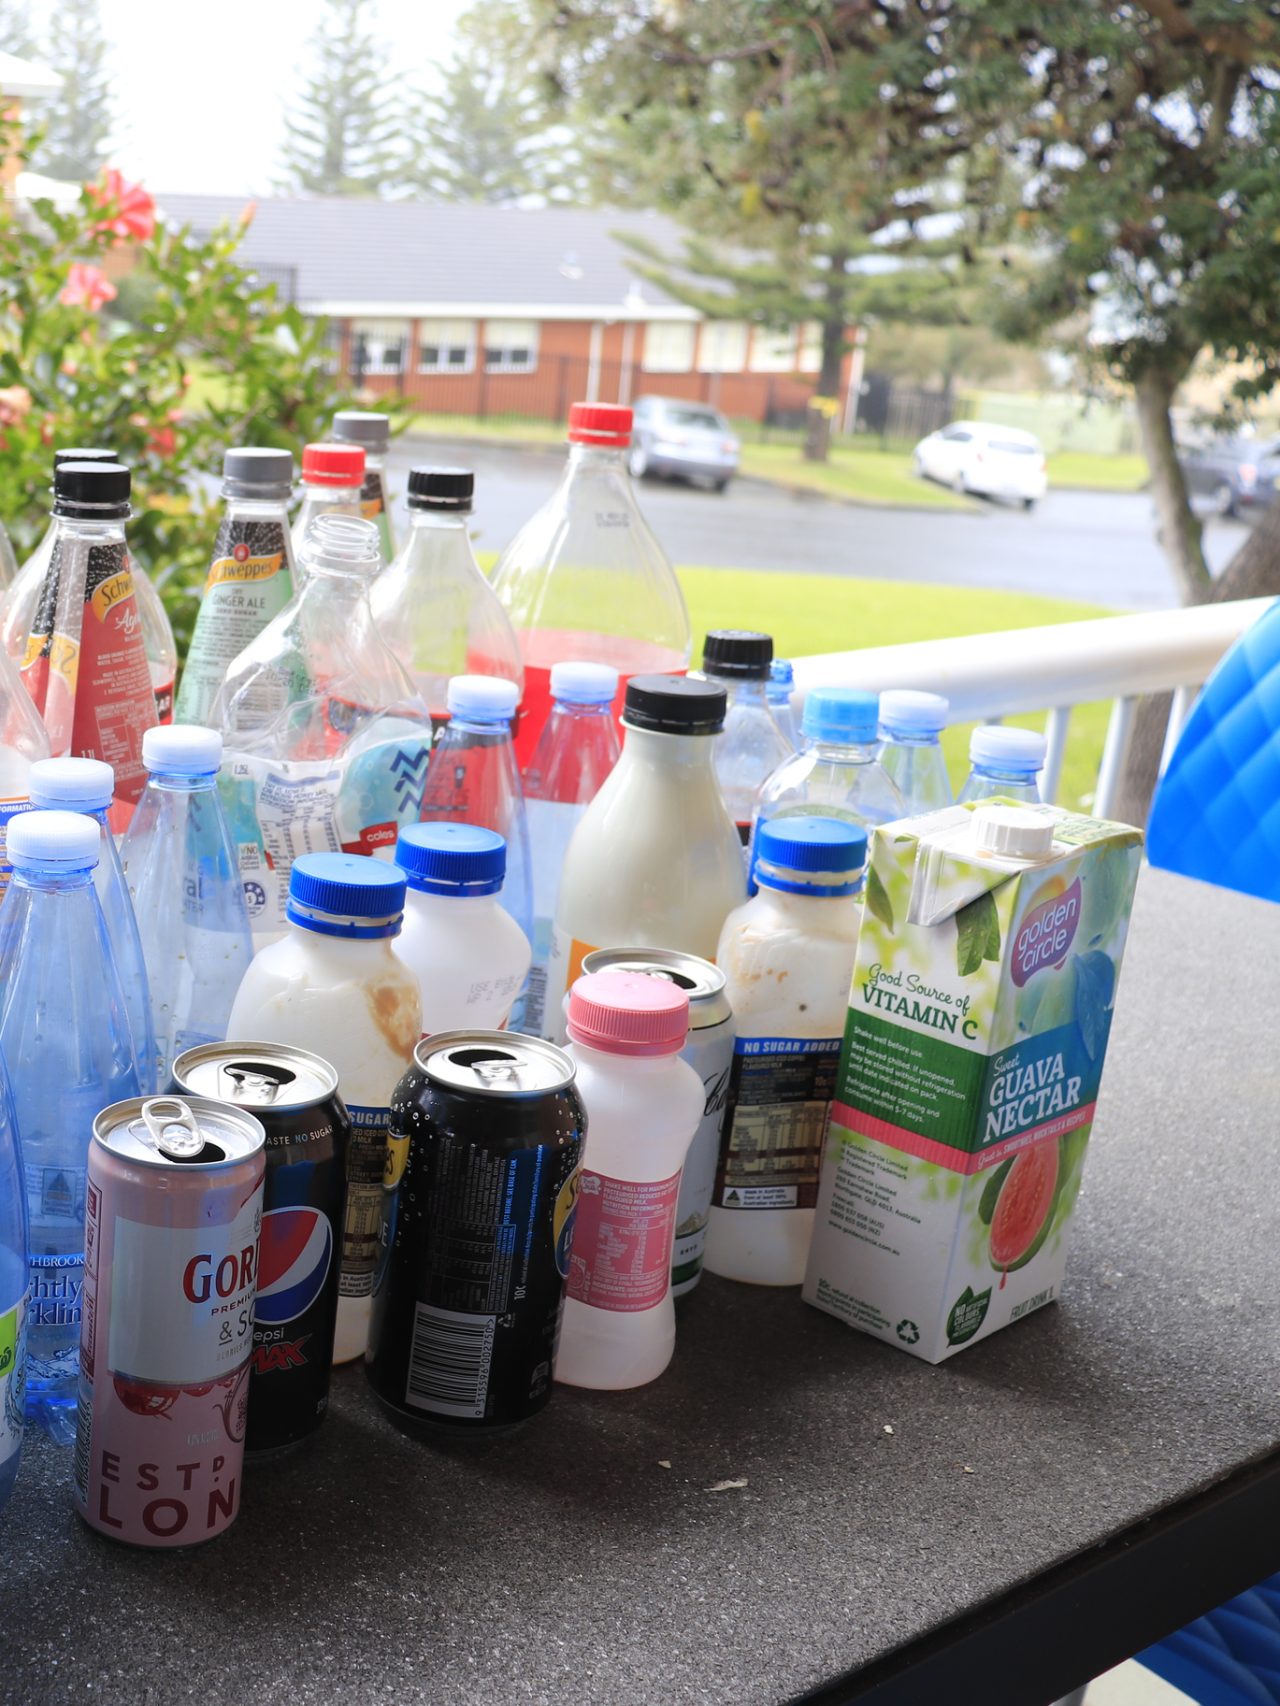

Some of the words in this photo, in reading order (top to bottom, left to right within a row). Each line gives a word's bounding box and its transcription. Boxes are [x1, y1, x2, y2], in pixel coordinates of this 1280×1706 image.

[247, 598, 266, 609] ALE
[366, 829, 395, 842] coles
[1018, 897, 1077, 957] golden
[1022, 928, 1068, 973] circle
[868, 963, 903, 988] Good
[906, 974, 953, 1005] Source
[955, 995, 971, 1016] of
[862, 983, 960, 1034] VITAMIN
[961, 1020, 978, 1040] C
[744, 1042, 760, 1053] NO
[762, 1041, 800, 1052] SUGAR
[803, 1041, 841, 1052] ADDED
[852, 1041, 865, 1052] Best
[865, 1046, 888, 1062] served
[853, 1025, 873, 1040] Shake
[873, 1034, 888, 1046] well
[888, 1039, 910, 1054] before
[848, 1061, 863, 1073] until
[863, 1067, 878, 1079] date
[878, 1073, 910, 1091] indicated
[909, 1085, 920, 1094] on
[850, 1052, 863, 1064] may
[864, 1057, 873, 1066] be
[873, 1060, 894, 1074] stored
[894, 1067, 922, 1084] without
[921, 1078, 966, 1101] refrigeration
[992, 1050, 1021, 1077] Sweet
[989, 1052, 1065, 1107] GUAVA
[844, 1086, 874, 1101] consume
[873, 1096, 895, 1112] within
[906, 1111, 924, 1124] days.
[846, 1074, 881, 1096] Refrigerate
[880, 1088, 897, 1101] after
[897, 1095, 927, 1115] opening
[926, 1106, 940, 1118] and
[982, 1075, 1083, 1143] NECTAR
[266, 1136, 291, 1146] ASTE
[295, 1133, 308, 1143] NO
[309, 1124, 334, 1141] SUGAR
[846, 1149, 876, 1168] Registered
[876, 1162, 908, 1180] Trademark
[885, 1157, 909, 1172] Limited
[874, 1182, 897, 1197] Limited
[894, 1209, 922, 1225] Australia
[253, 1328, 285, 1343] epsi
